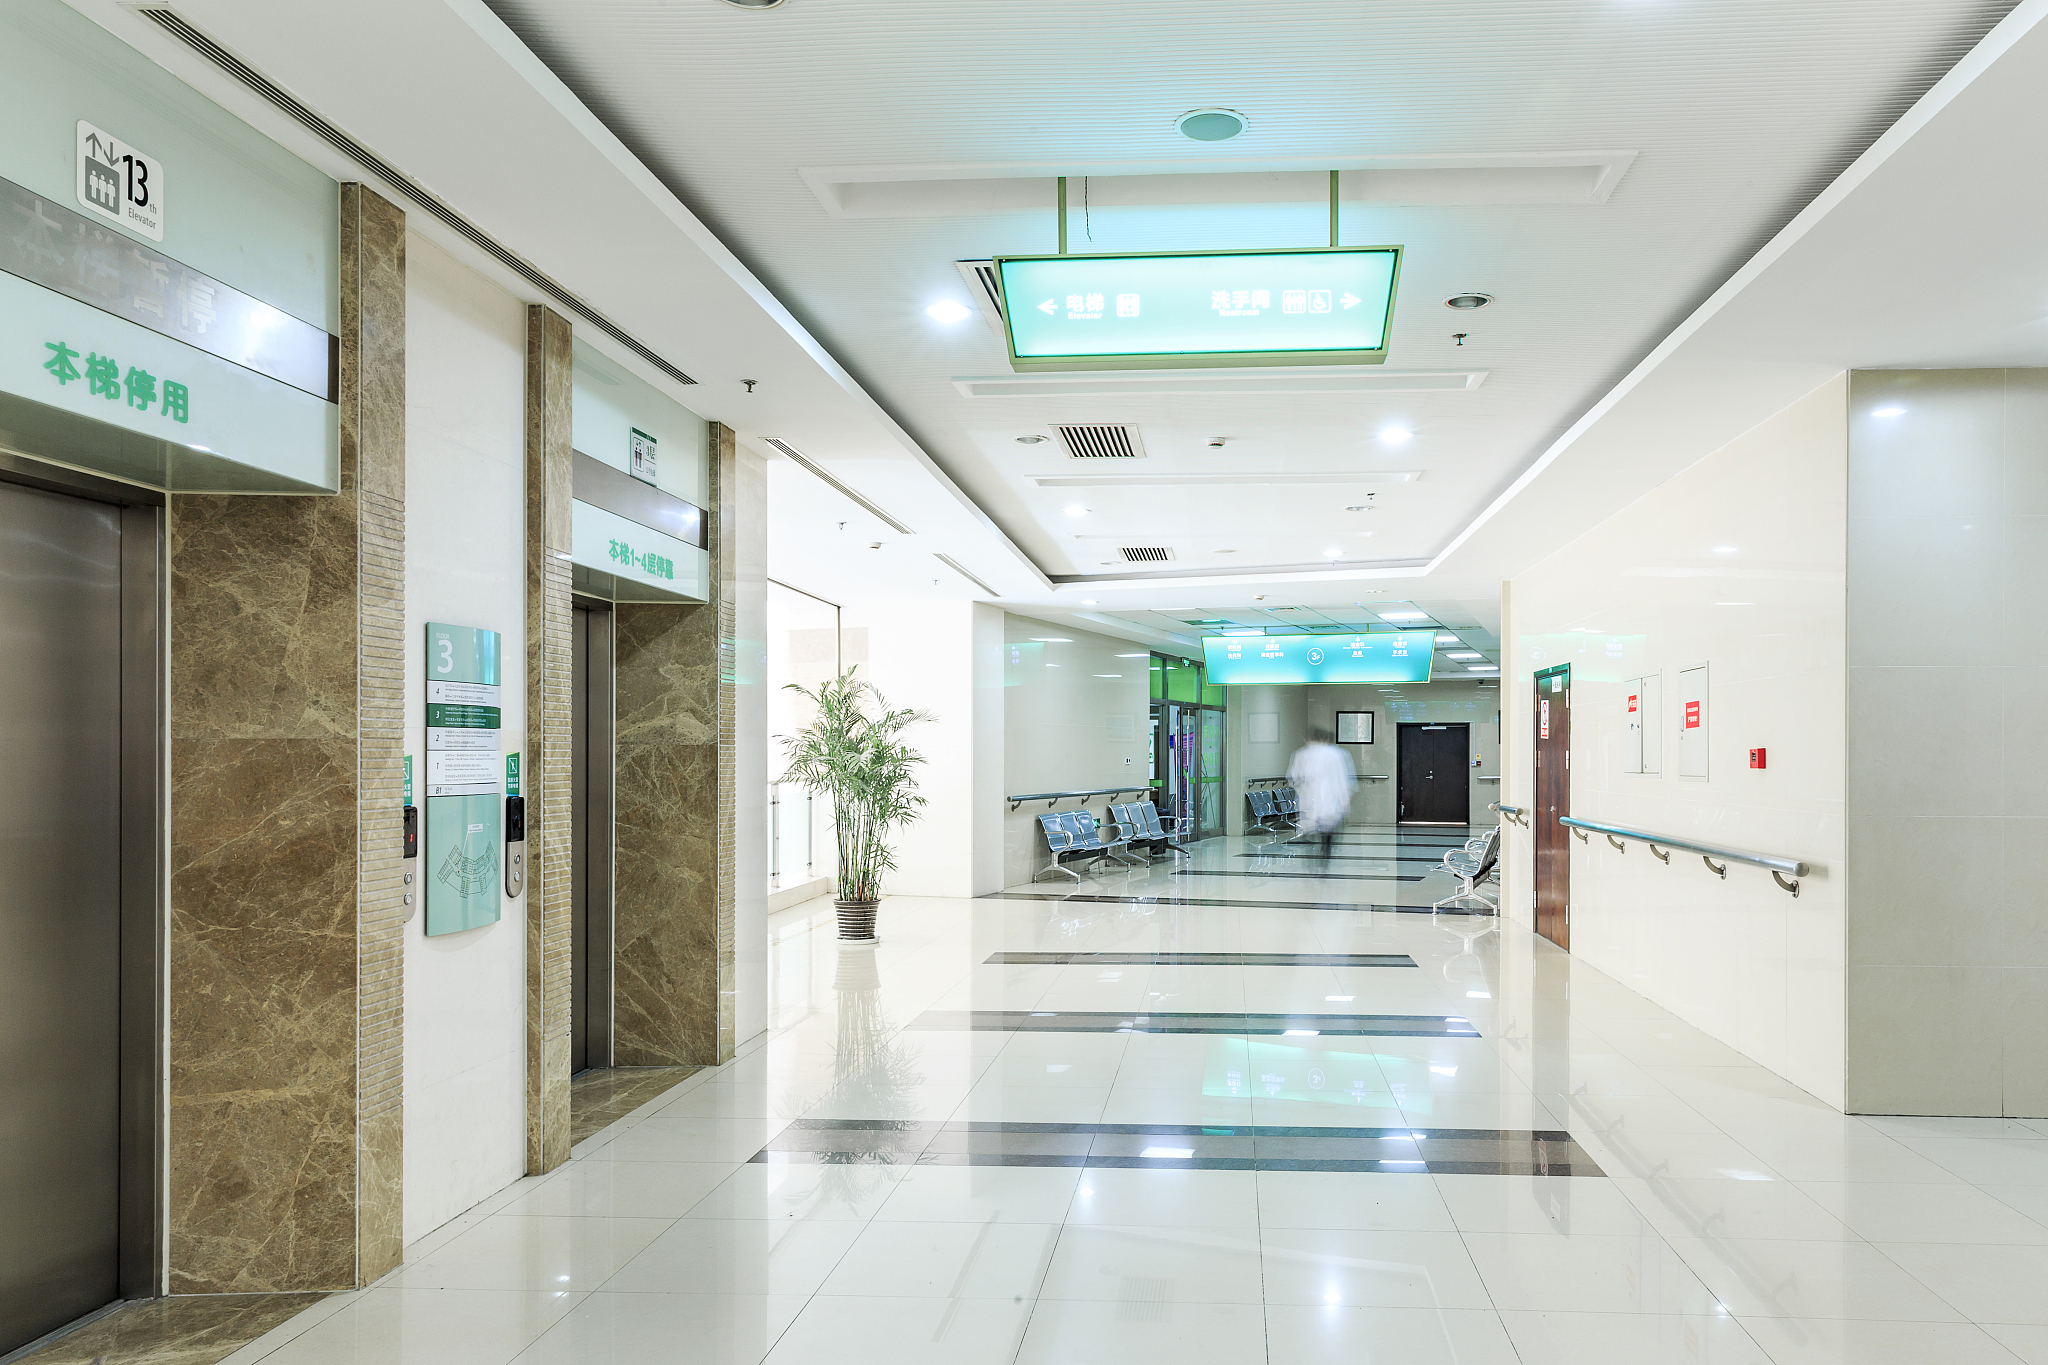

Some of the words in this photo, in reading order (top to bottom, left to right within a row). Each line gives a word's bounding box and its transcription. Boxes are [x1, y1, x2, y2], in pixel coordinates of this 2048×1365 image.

[122, 154, 149, 208] 13
[149, 203, 157, 215] th
[128, 207, 157, 230] Elevator
[1066, 293, 1105, 312] 电梯
[1211, 289, 1270, 310] 洗手间
[1067, 312, 1103, 320] Elevator
[1219, 308, 1260, 317] Restroom
[44, 341, 189, 424] 本梯停用
[437, 639, 454, 674] 3
[435, 710, 441, 719] 3
[435, 734, 441, 742] 2
[435, 786, 443, 795] B1
